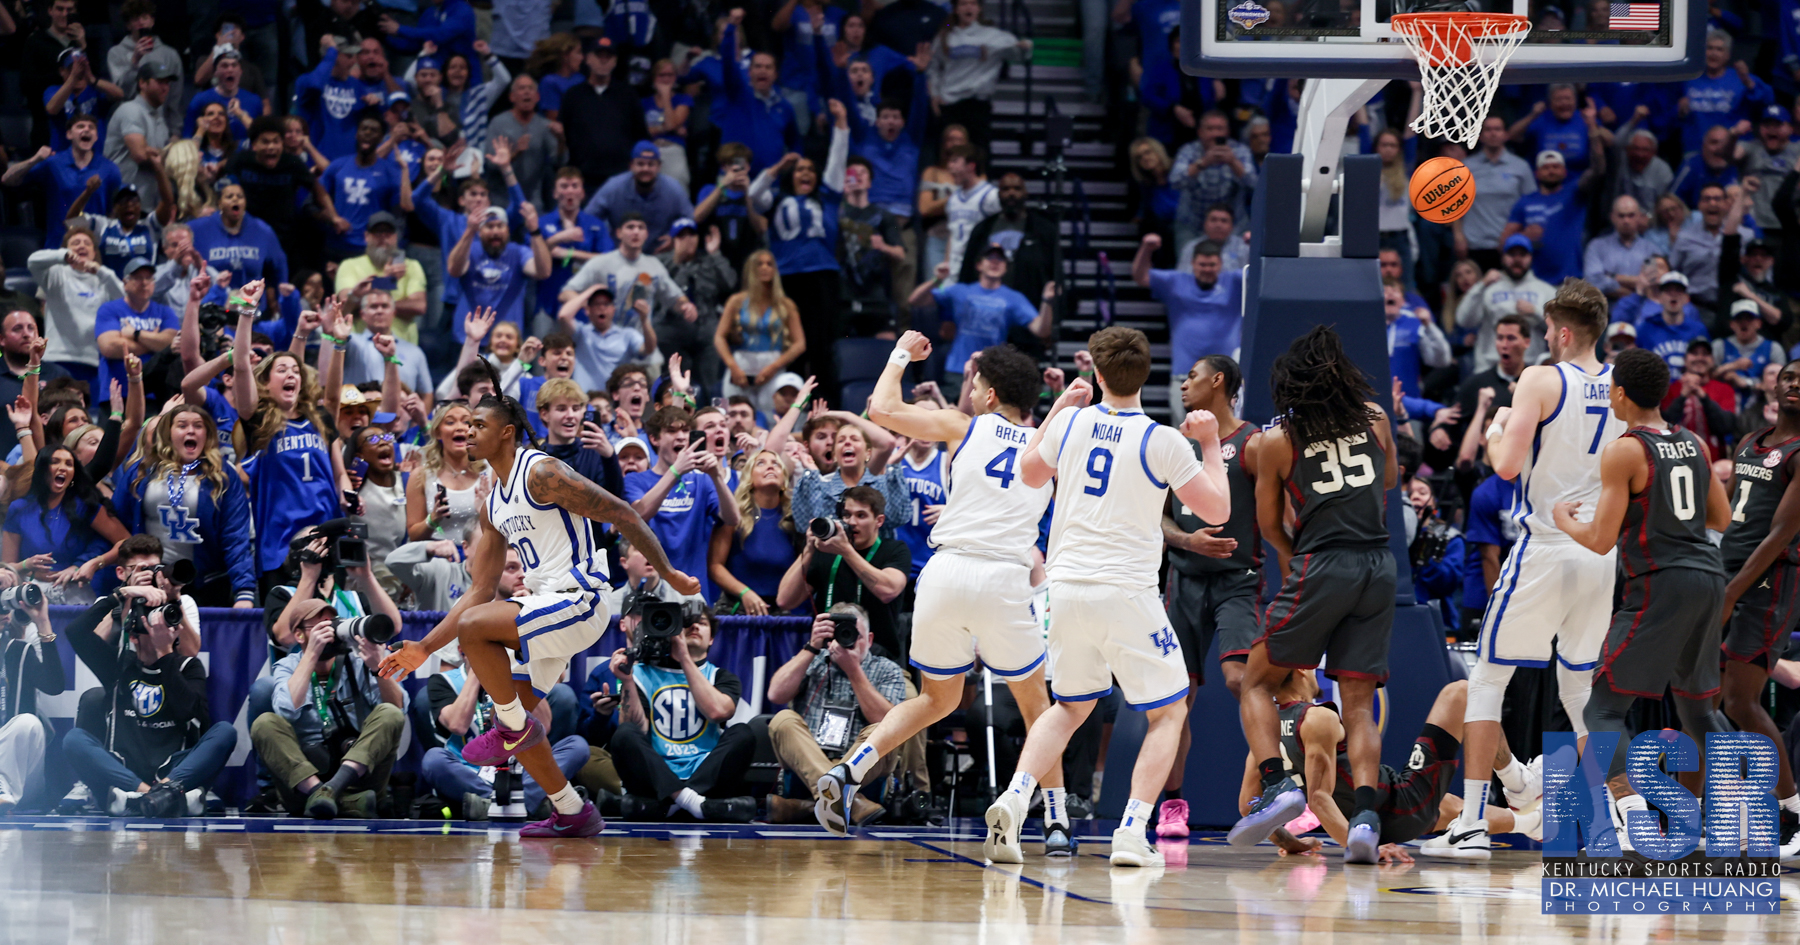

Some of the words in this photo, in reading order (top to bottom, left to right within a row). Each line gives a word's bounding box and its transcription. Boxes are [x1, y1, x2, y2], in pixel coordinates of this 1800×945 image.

[344, 177, 371, 205] UK
[1422, 175, 1463, 204] Wilson
[1441, 193, 1469, 216] NCAA
[995, 425, 1027, 445] BREA
[1091, 422, 1123, 443] NOAH
[1585, 406, 1609, 454] 7
[276, 433, 328, 454] KENTUCK
[1656, 441, 1697, 459] FEARS
[301, 452, 313, 481] 1
[985, 446, 1018, 489] 4
[1084, 447, 1113, 497] 9
[1303, 432, 1376, 495] 35
[1735, 463, 1773, 481] OONERS
[661, 492, 695, 507] entucky
[906, 477, 943, 501] TUCKY
[1670, 465, 1696, 520] 0
[1732, 480, 1753, 522] 1
[157, 505, 203, 543] UK
[499, 514, 536, 538] ENTUCKY
[1148, 624, 1179, 658] UK
[1280, 720, 1294, 736] NE
[665, 744, 699, 756] 2025
